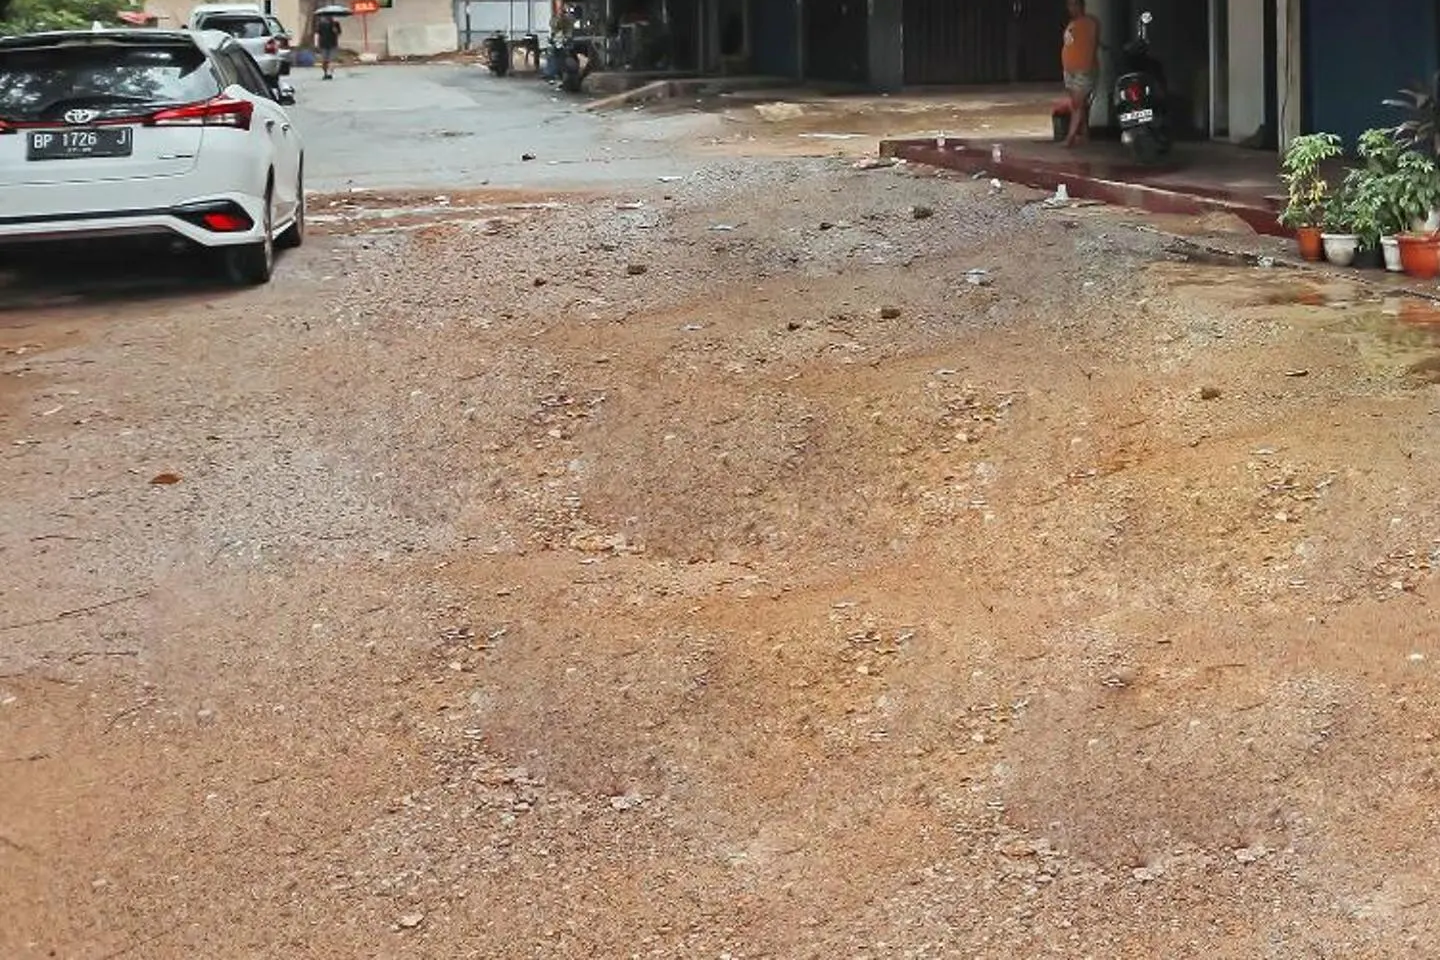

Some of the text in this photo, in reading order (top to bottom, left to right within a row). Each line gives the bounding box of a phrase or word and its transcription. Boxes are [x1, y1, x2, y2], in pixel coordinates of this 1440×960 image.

[33, 129, 126, 150] BP 1726 J
